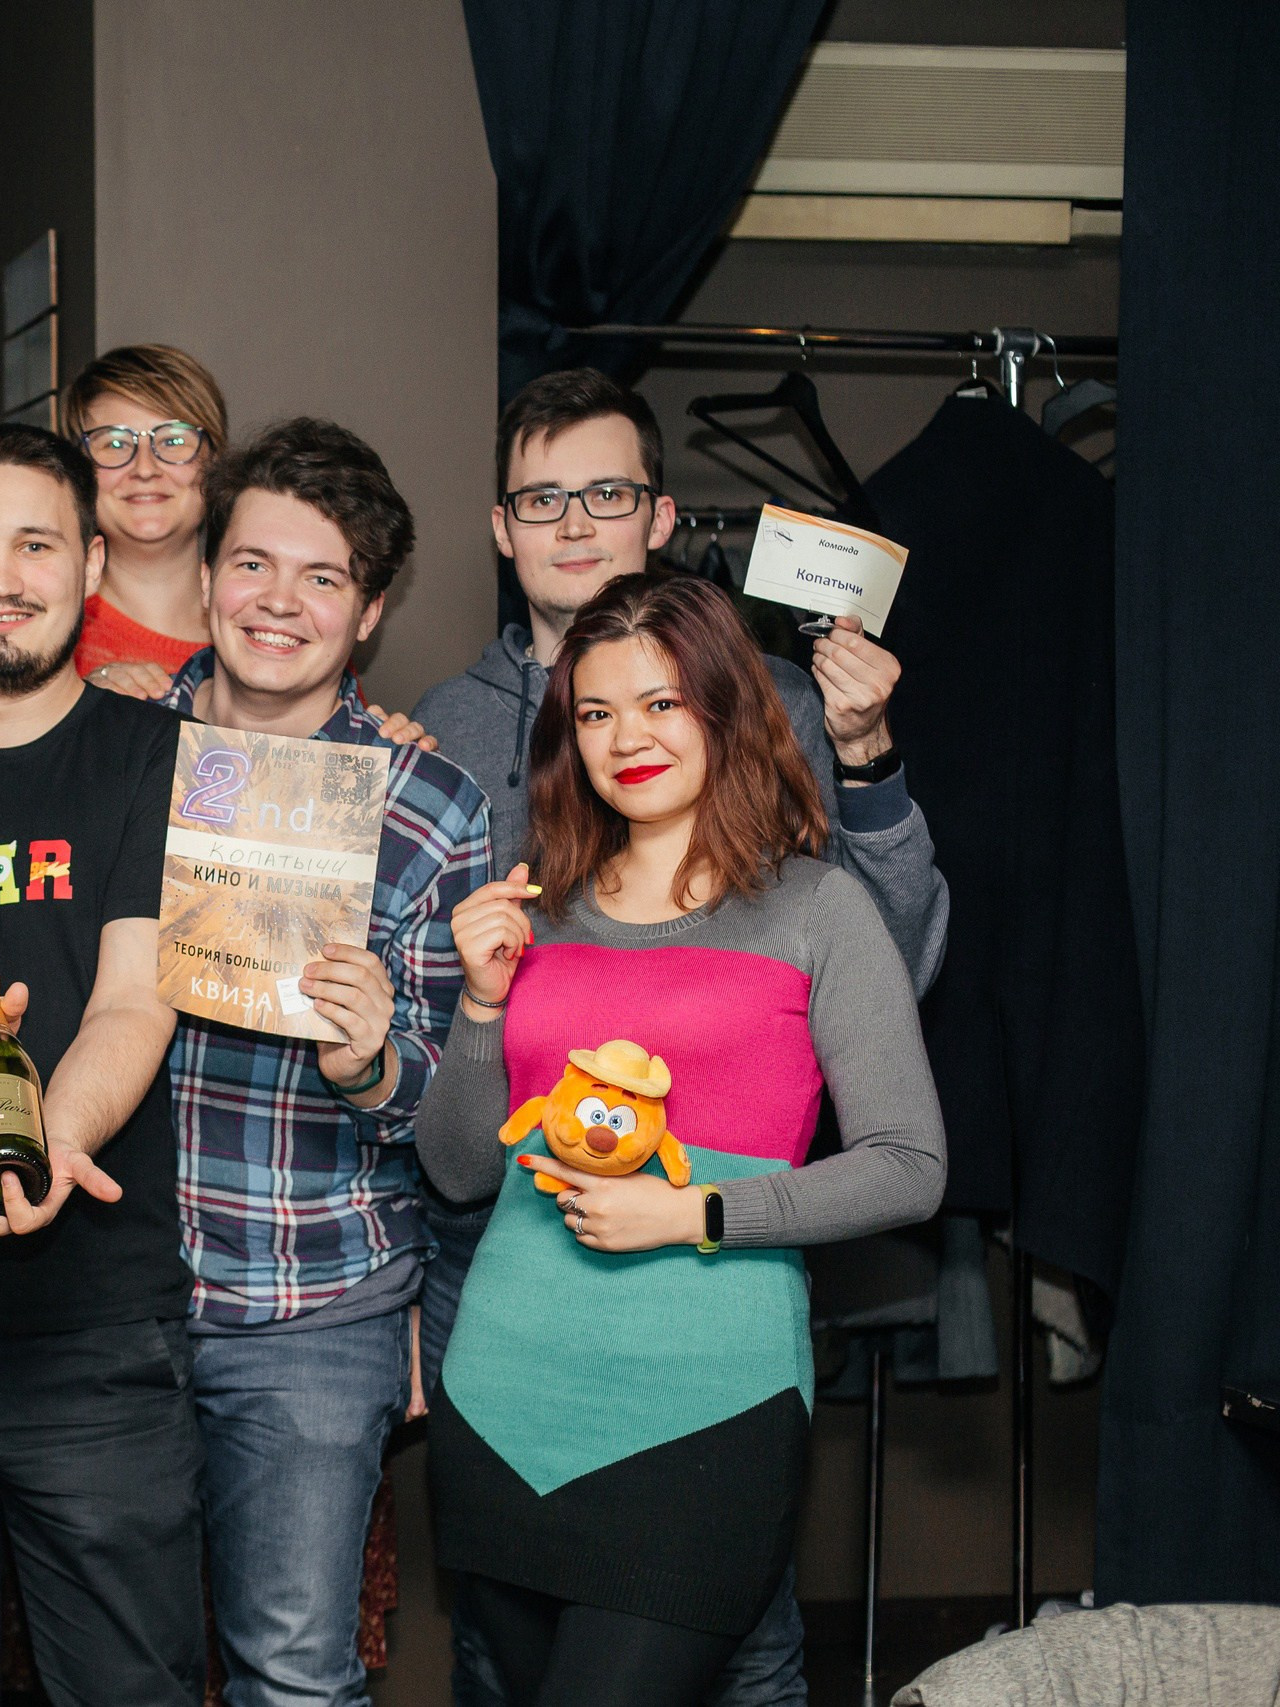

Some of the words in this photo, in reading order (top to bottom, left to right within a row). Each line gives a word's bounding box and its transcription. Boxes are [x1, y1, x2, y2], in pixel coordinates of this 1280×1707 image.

[818, 538, 859, 556] Команда
[796, 567, 864, 597] Копатычи
[271, 745, 317, 764] МАРТА
[209, 841, 348, 874] КОПАТЫЧИ
[193, 864, 241, 887] КИНО
[248, 873, 260, 891] И
[267, 876, 342, 900] МУЗЫКА
[174, 941, 221, 965] ТЕОРИЯ
[191, 975, 273, 1013] КВИЗА
